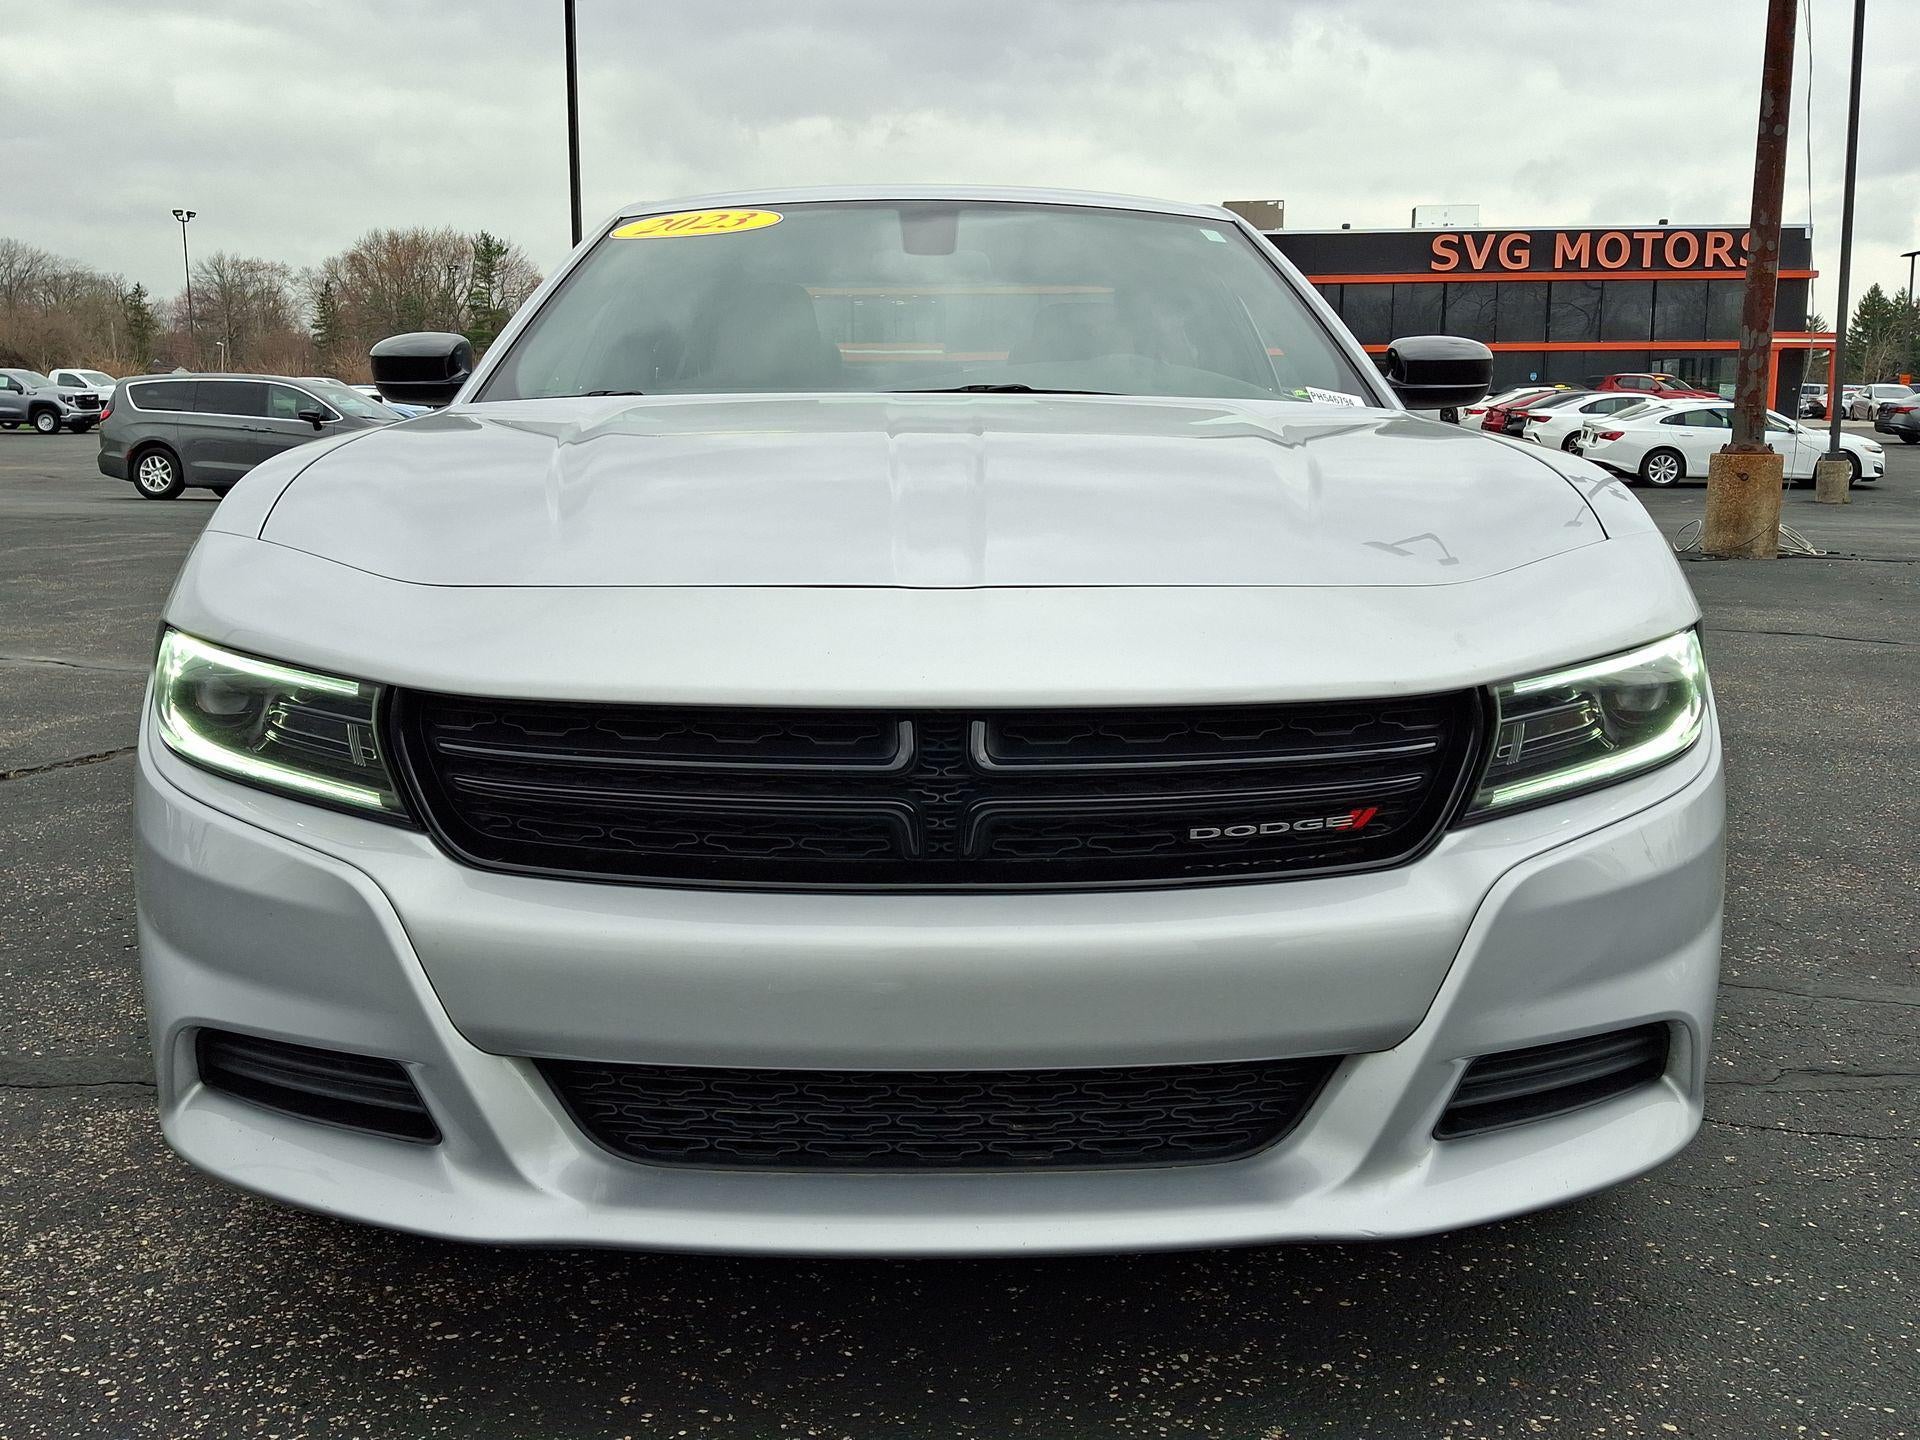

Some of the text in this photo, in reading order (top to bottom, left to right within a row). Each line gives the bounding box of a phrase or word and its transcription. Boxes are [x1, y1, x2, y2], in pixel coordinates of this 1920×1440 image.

[634, 213, 757, 235] 2023
[1430, 233, 1532, 271] SVG
[1190, 815, 1354, 839] DODGE
